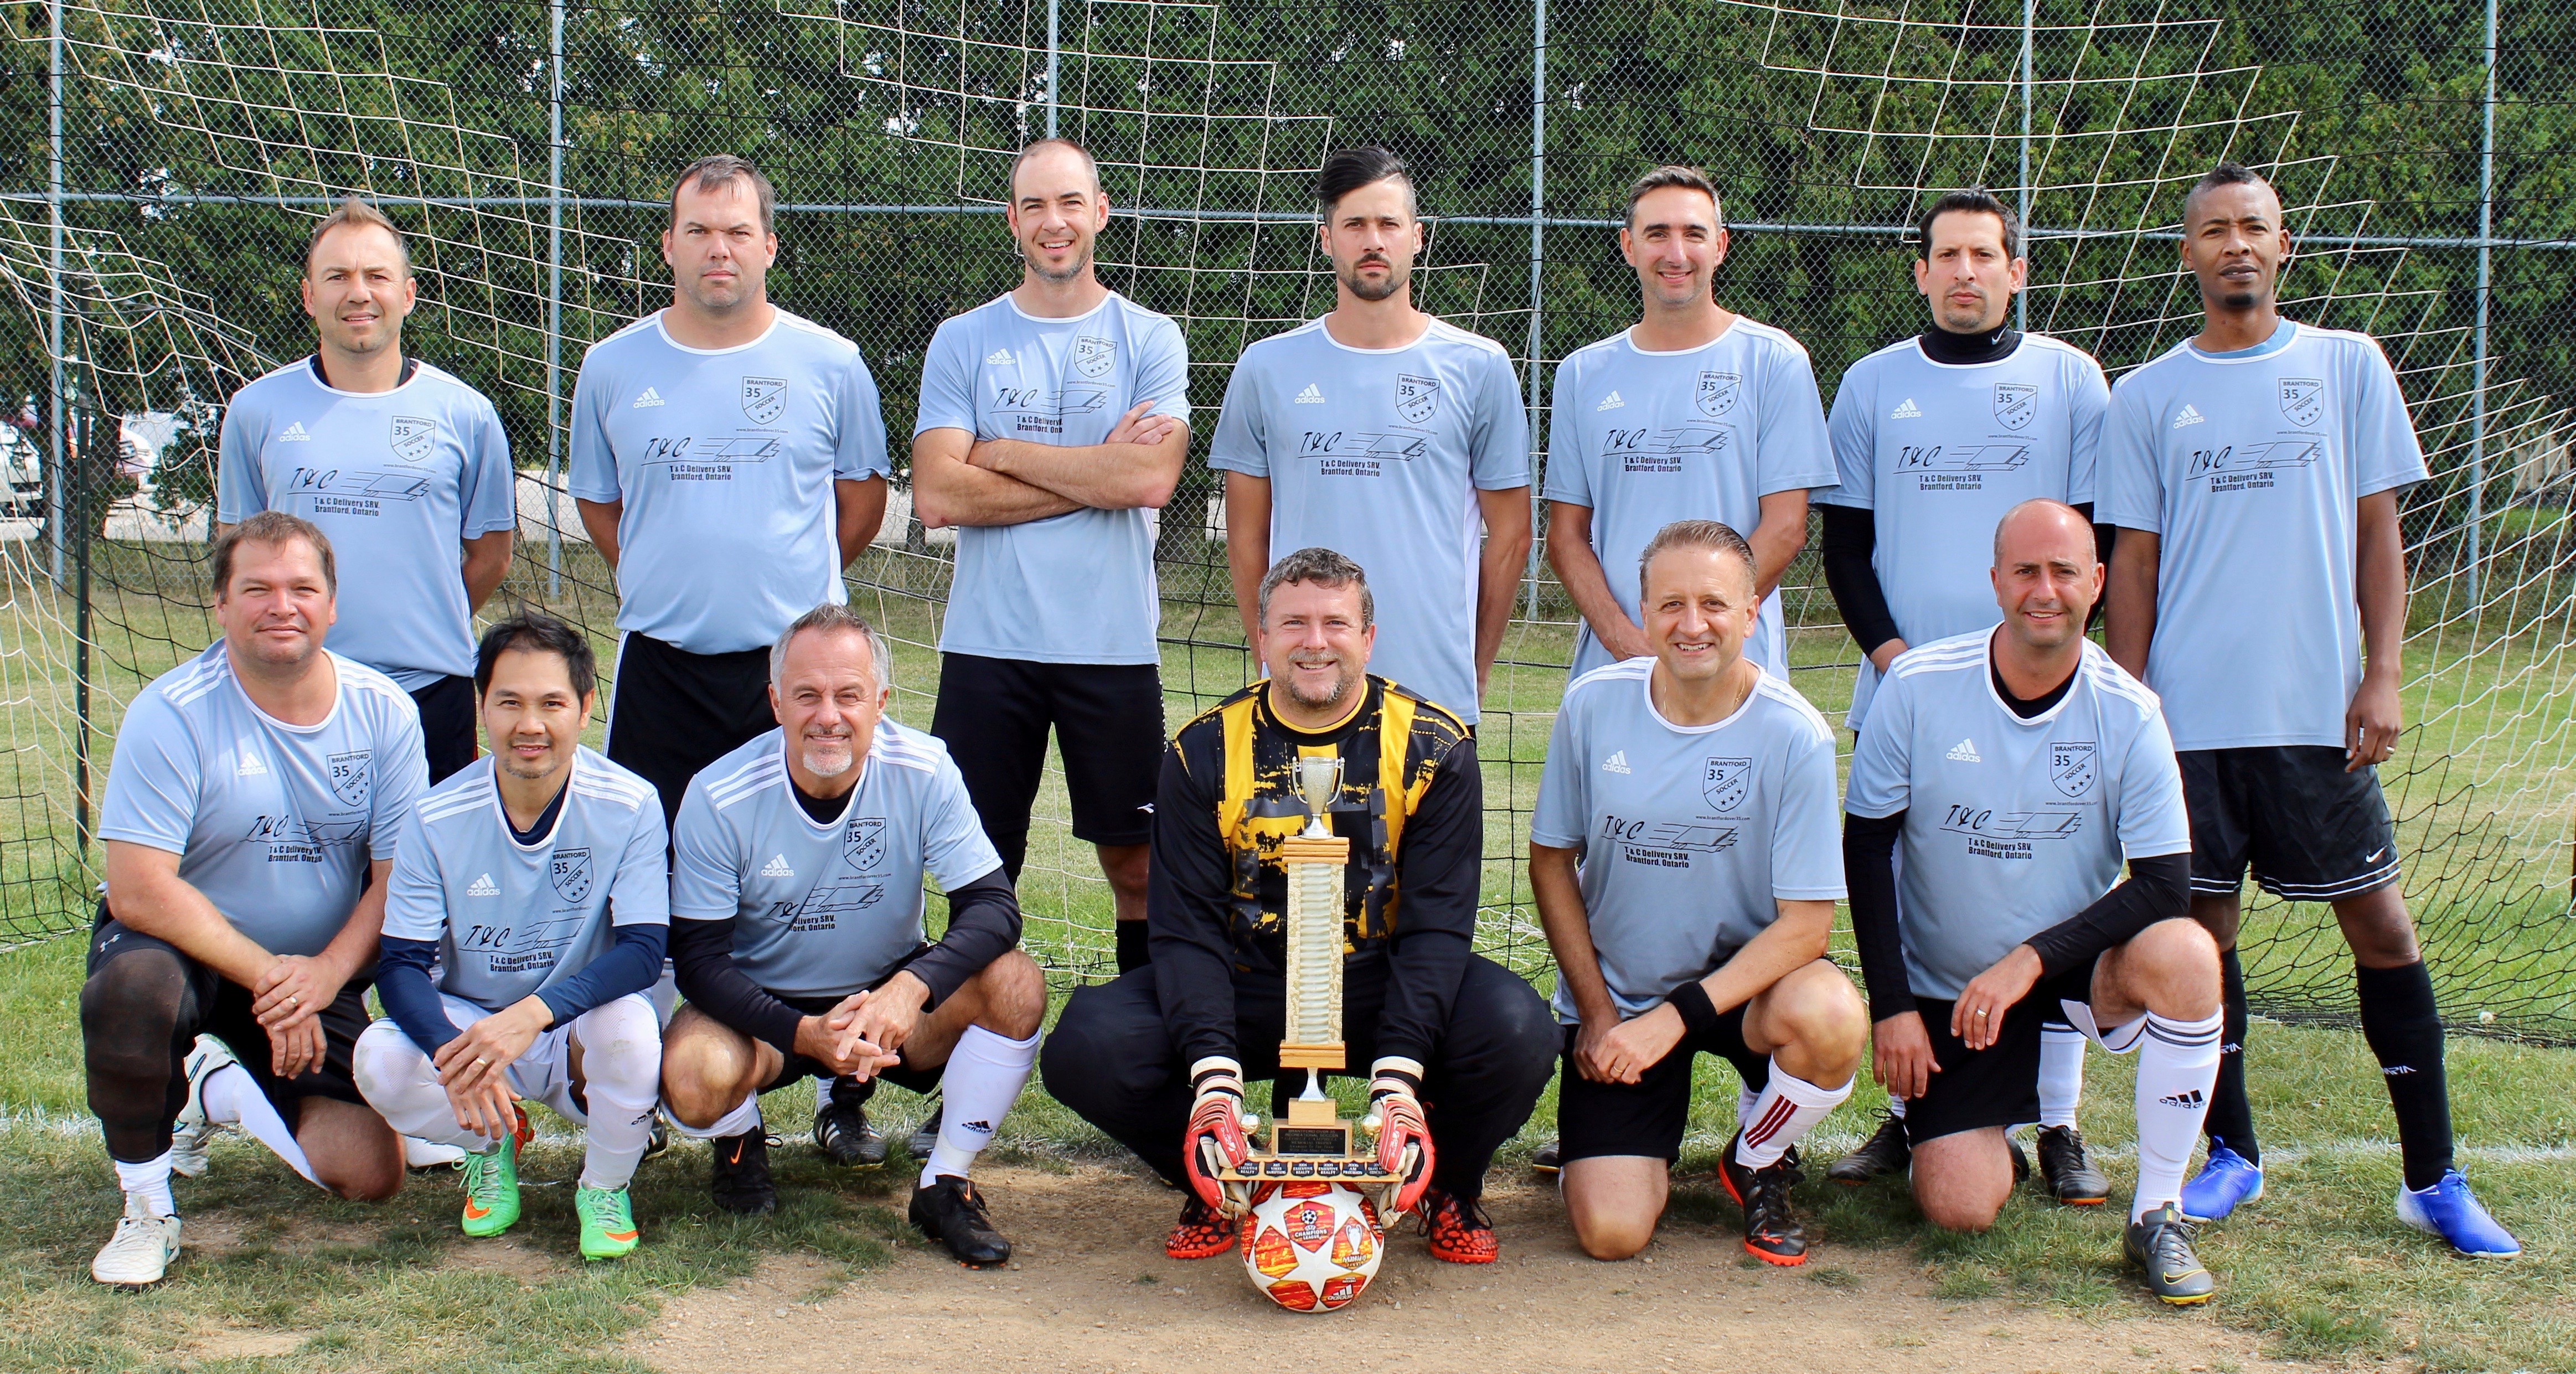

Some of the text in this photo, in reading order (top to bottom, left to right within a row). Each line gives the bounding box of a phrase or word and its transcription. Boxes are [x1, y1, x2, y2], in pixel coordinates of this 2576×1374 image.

[1081, 339, 1113, 348] BRANTFORD
[1078, 345, 1093, 354] 35
[1086, 354, 1106, 364] SOCCER
[1401, 377, 1436, 387] BRANTFORD
[1701, 381, 1715, 391] 35
[746, 388, 761, 397] 35
[1400, 385, 1415, 396] 35
[2283, 389, 2299, 399] 35
[1707, 390, 1728, 403] SOCCER
[1997, 394, 2012, 404] 35
[633, 398, 665, 409] adidas
[755, 396, 776, 410] SOCCER
[1408, 396, 1428, 409] SOCCER
[1597, 401, 1624, 412] adidas
[2294, 397, 2314, 411] SOCCER
[2006, 402, 2027, 415] SOCCER
[1891, 410, 1921, 419] adidas
[396, 419, 432, 427] BRANTFORD
[2174, 415, 2203, 430] adidas
[394, 426, 410, 436] 35
[280, 433, 310, 442] adidas
[404, 435, 425, 447] SOCCER
[687, 465, 716, 473] Delivery
[1338, 461, 1365, 469] Delivery
[2228, 474, 2257, 484] Delivery
[333, 499, 364, 508] Delivery
[353, 508, 379, 516] Ontario
[332, 753, 369, 763] BRANTFORD
[1947, 751, 1980, 763] adidas
[2054, 755, 2070, 766] 35
[239, 766, 267, 776] adidas
[333, 766, 349, 777] 35
[1602, 763, 1630, 774] adidas
[2064, 763, 2086, 781] SOCCER
[1708, 769, 1723, 780] 35
[346, 772, 365, 791] SOCCER
[1716, 778, 1738, 795] SOCCER
[847, 831, 861, 843] 35
[856, 838, 876, 856] SOCCER
[1986, 840, 2016, 850] Delivery
[286, 846, 313, 855] Delivery
[553, 851, 586, 860] BRANTFORD
[1642, 849, 1672, 859] Delivery
[2005, 851, 2032, 859] Ontario
[554, 862, 569, 874] 35
[1662, 858, 1689, 868] Ontario
[761, 867, 794, 877] adidas
[565, 869, 584, 887] SOCCER
[467, 888, 500, 896] adidas
[508, 954, 537, 964] Delivery
[528, 960, 554, 970] Ontario
[2159, 1098, 2206, 1109] adidas
[1294, 1229, 1327, 1237] CHAMPIONS
